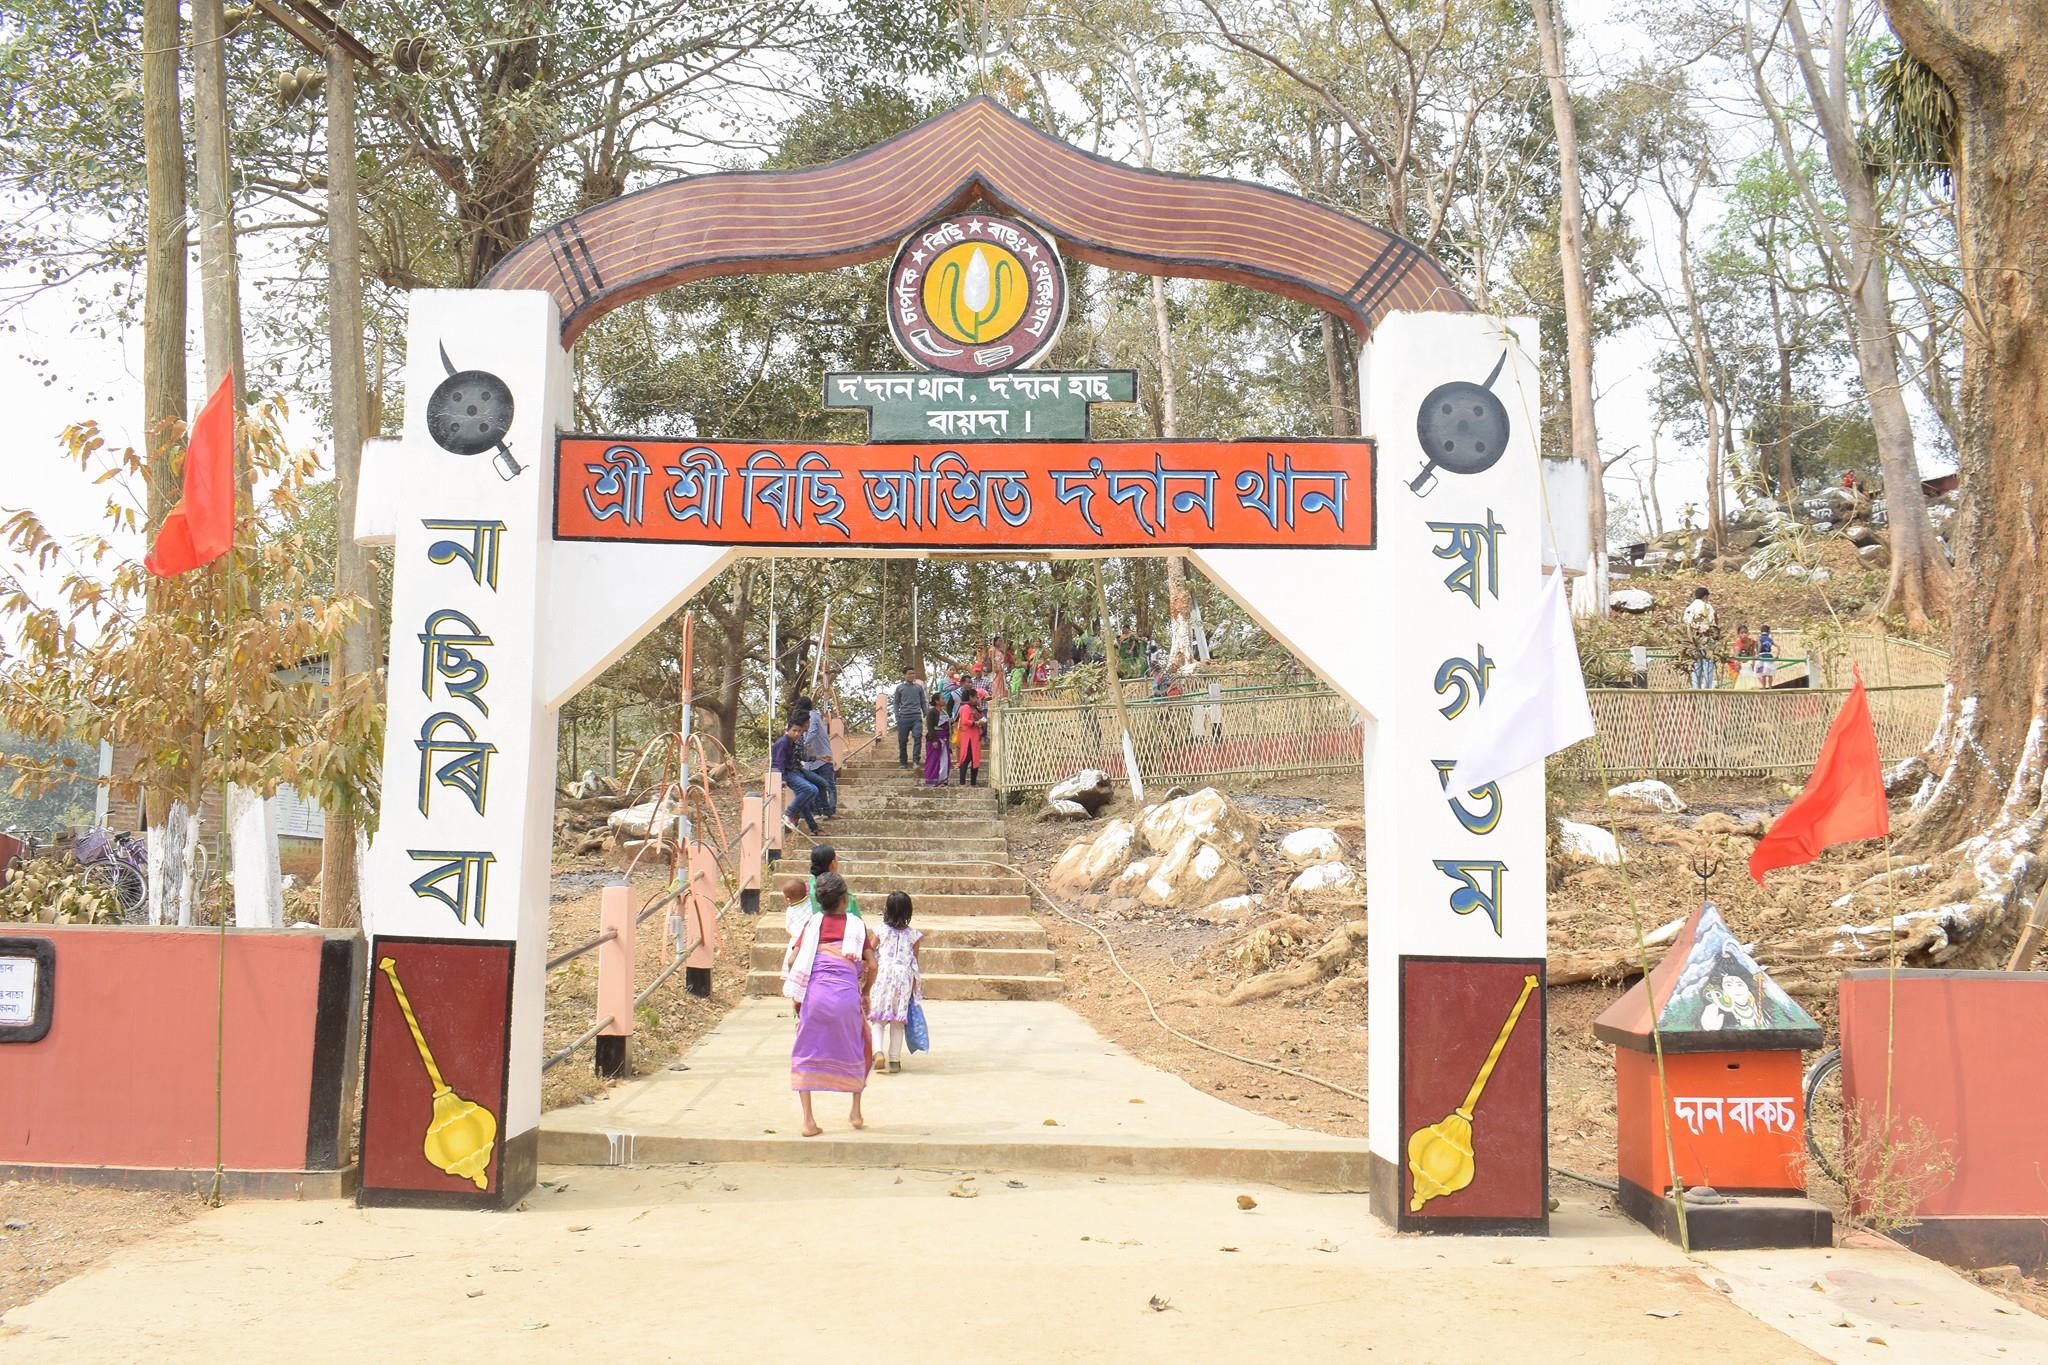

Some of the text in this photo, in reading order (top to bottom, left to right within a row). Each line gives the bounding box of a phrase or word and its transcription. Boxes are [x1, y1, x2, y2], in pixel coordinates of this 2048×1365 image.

[1067, 376, 1113, 401] হাচু
[738, 449, 852, 538] ৰিছি
[1235, 452, 1350, 533] থান
[1673, 1097, 1796, 1136] দান বাকচ
